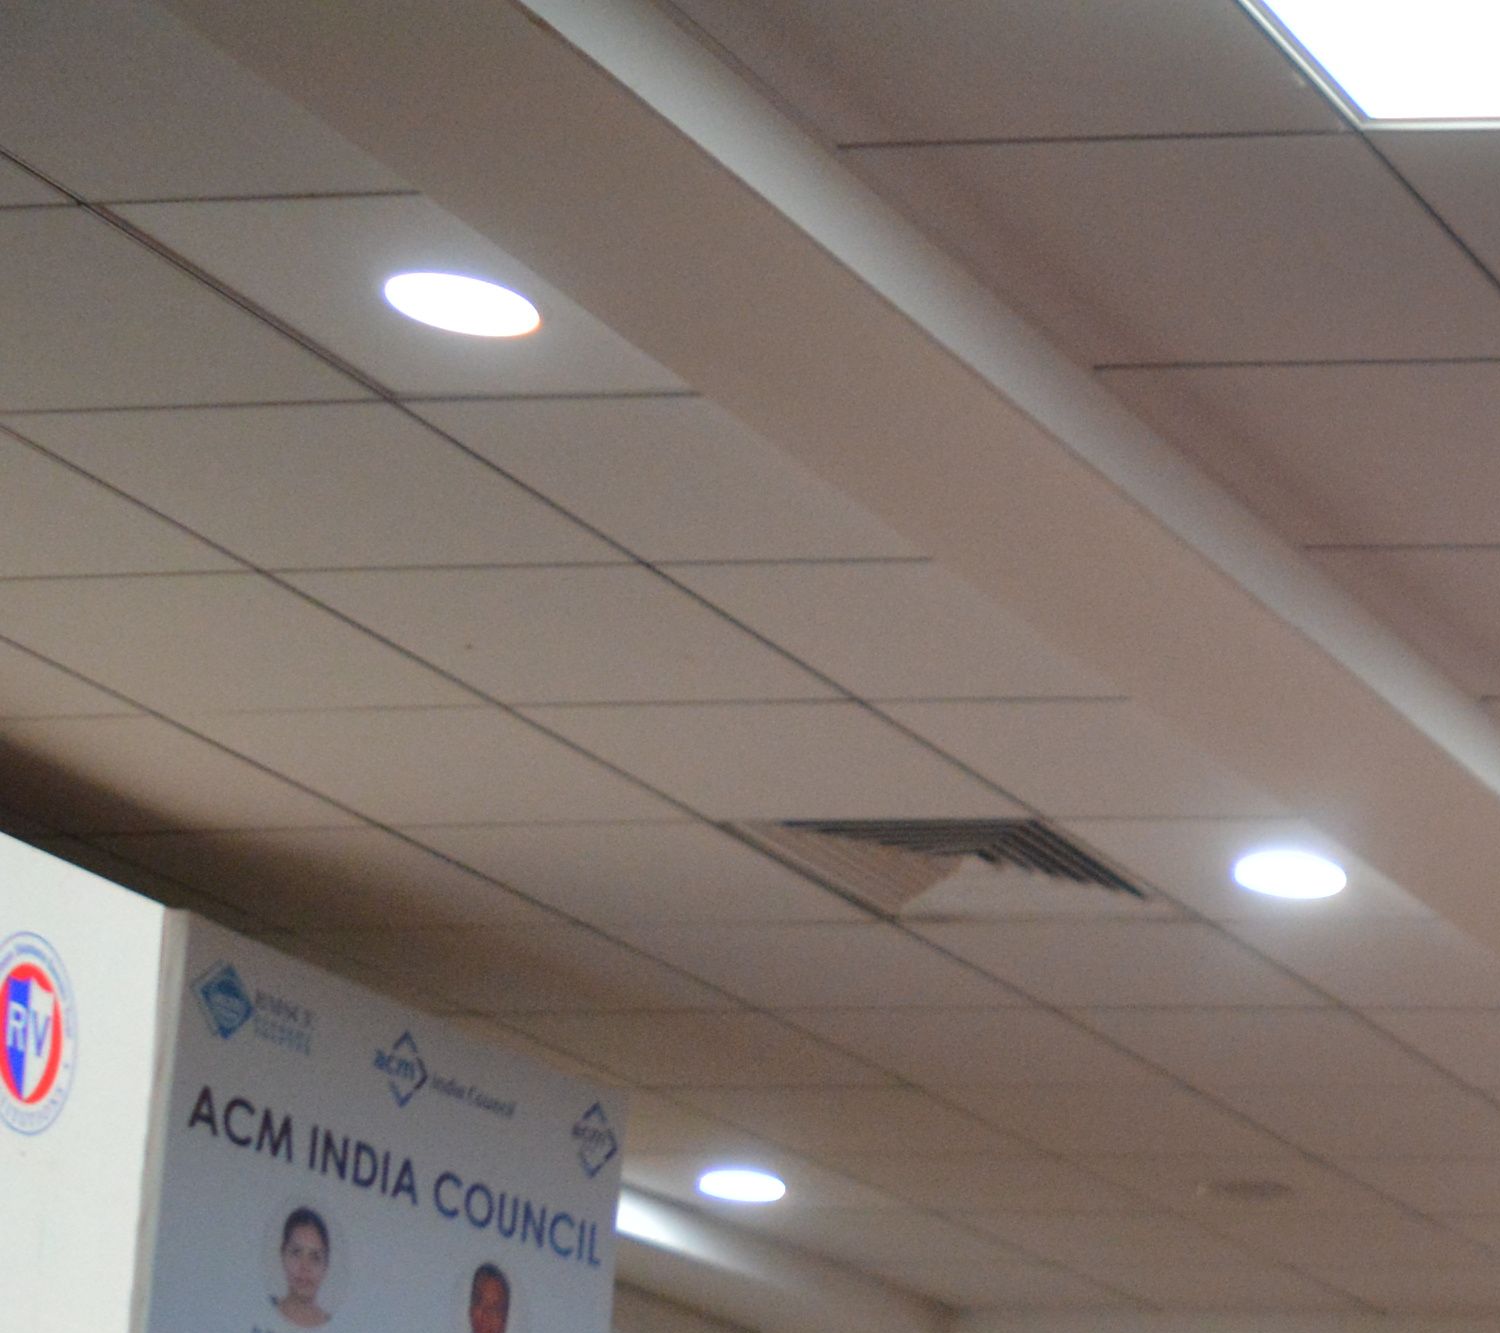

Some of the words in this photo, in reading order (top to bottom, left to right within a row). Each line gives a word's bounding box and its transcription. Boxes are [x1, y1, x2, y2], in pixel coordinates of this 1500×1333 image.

[7, 1001, 51, 1058] RV
[188, 1085, 294, 1164] ACM
[308, 1124, 419, 1206] INDIA
[433, 1170, 601, 1267] COUNCIL
